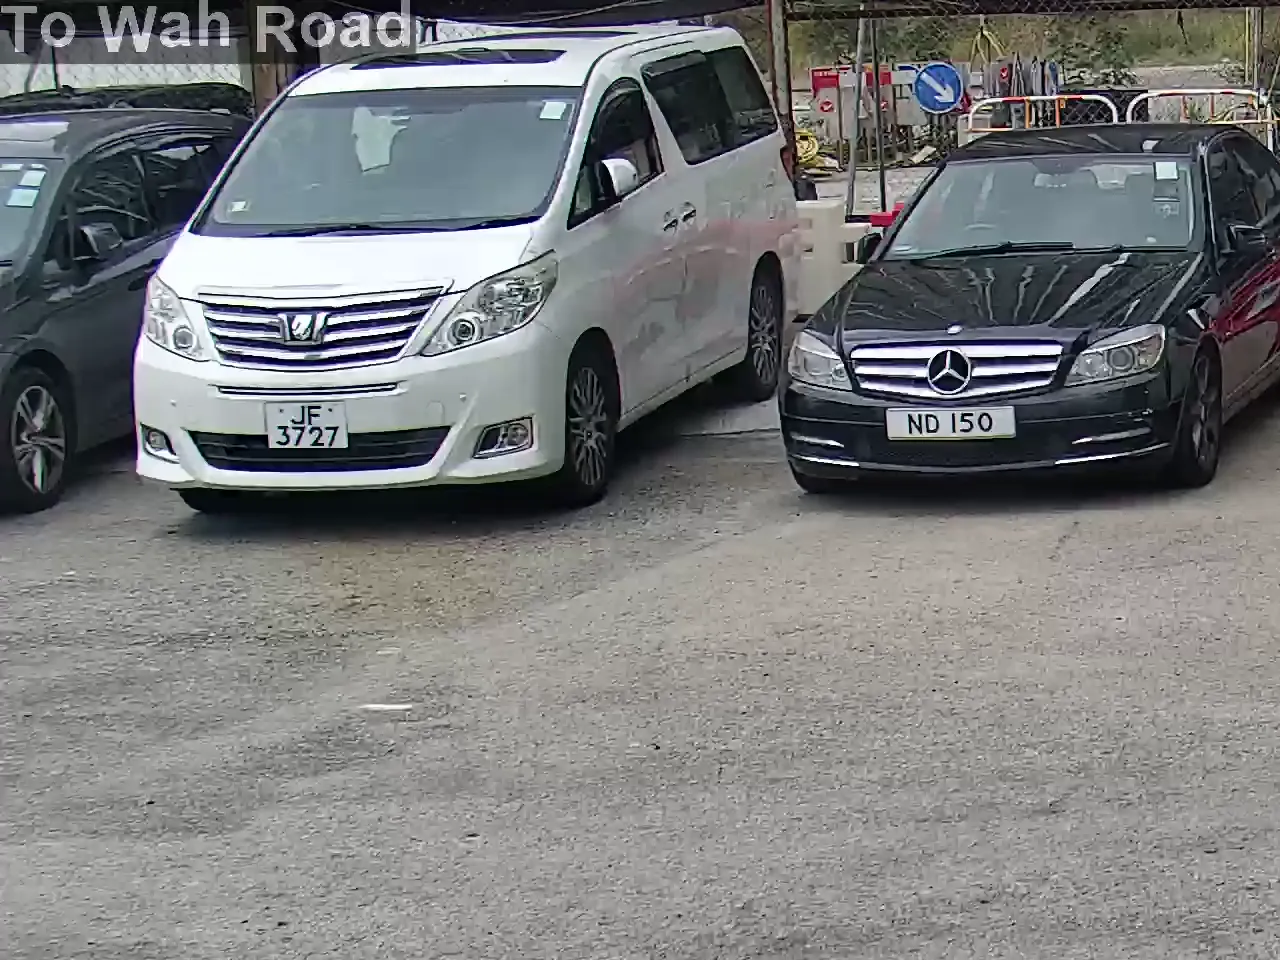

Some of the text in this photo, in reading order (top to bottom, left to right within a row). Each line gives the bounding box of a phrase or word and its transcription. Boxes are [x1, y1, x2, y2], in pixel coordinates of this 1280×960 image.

[291, 405, 322, 425] JF
[907, 412, 993, 434] ND 150
[275, 425, 340, 447] 3727
